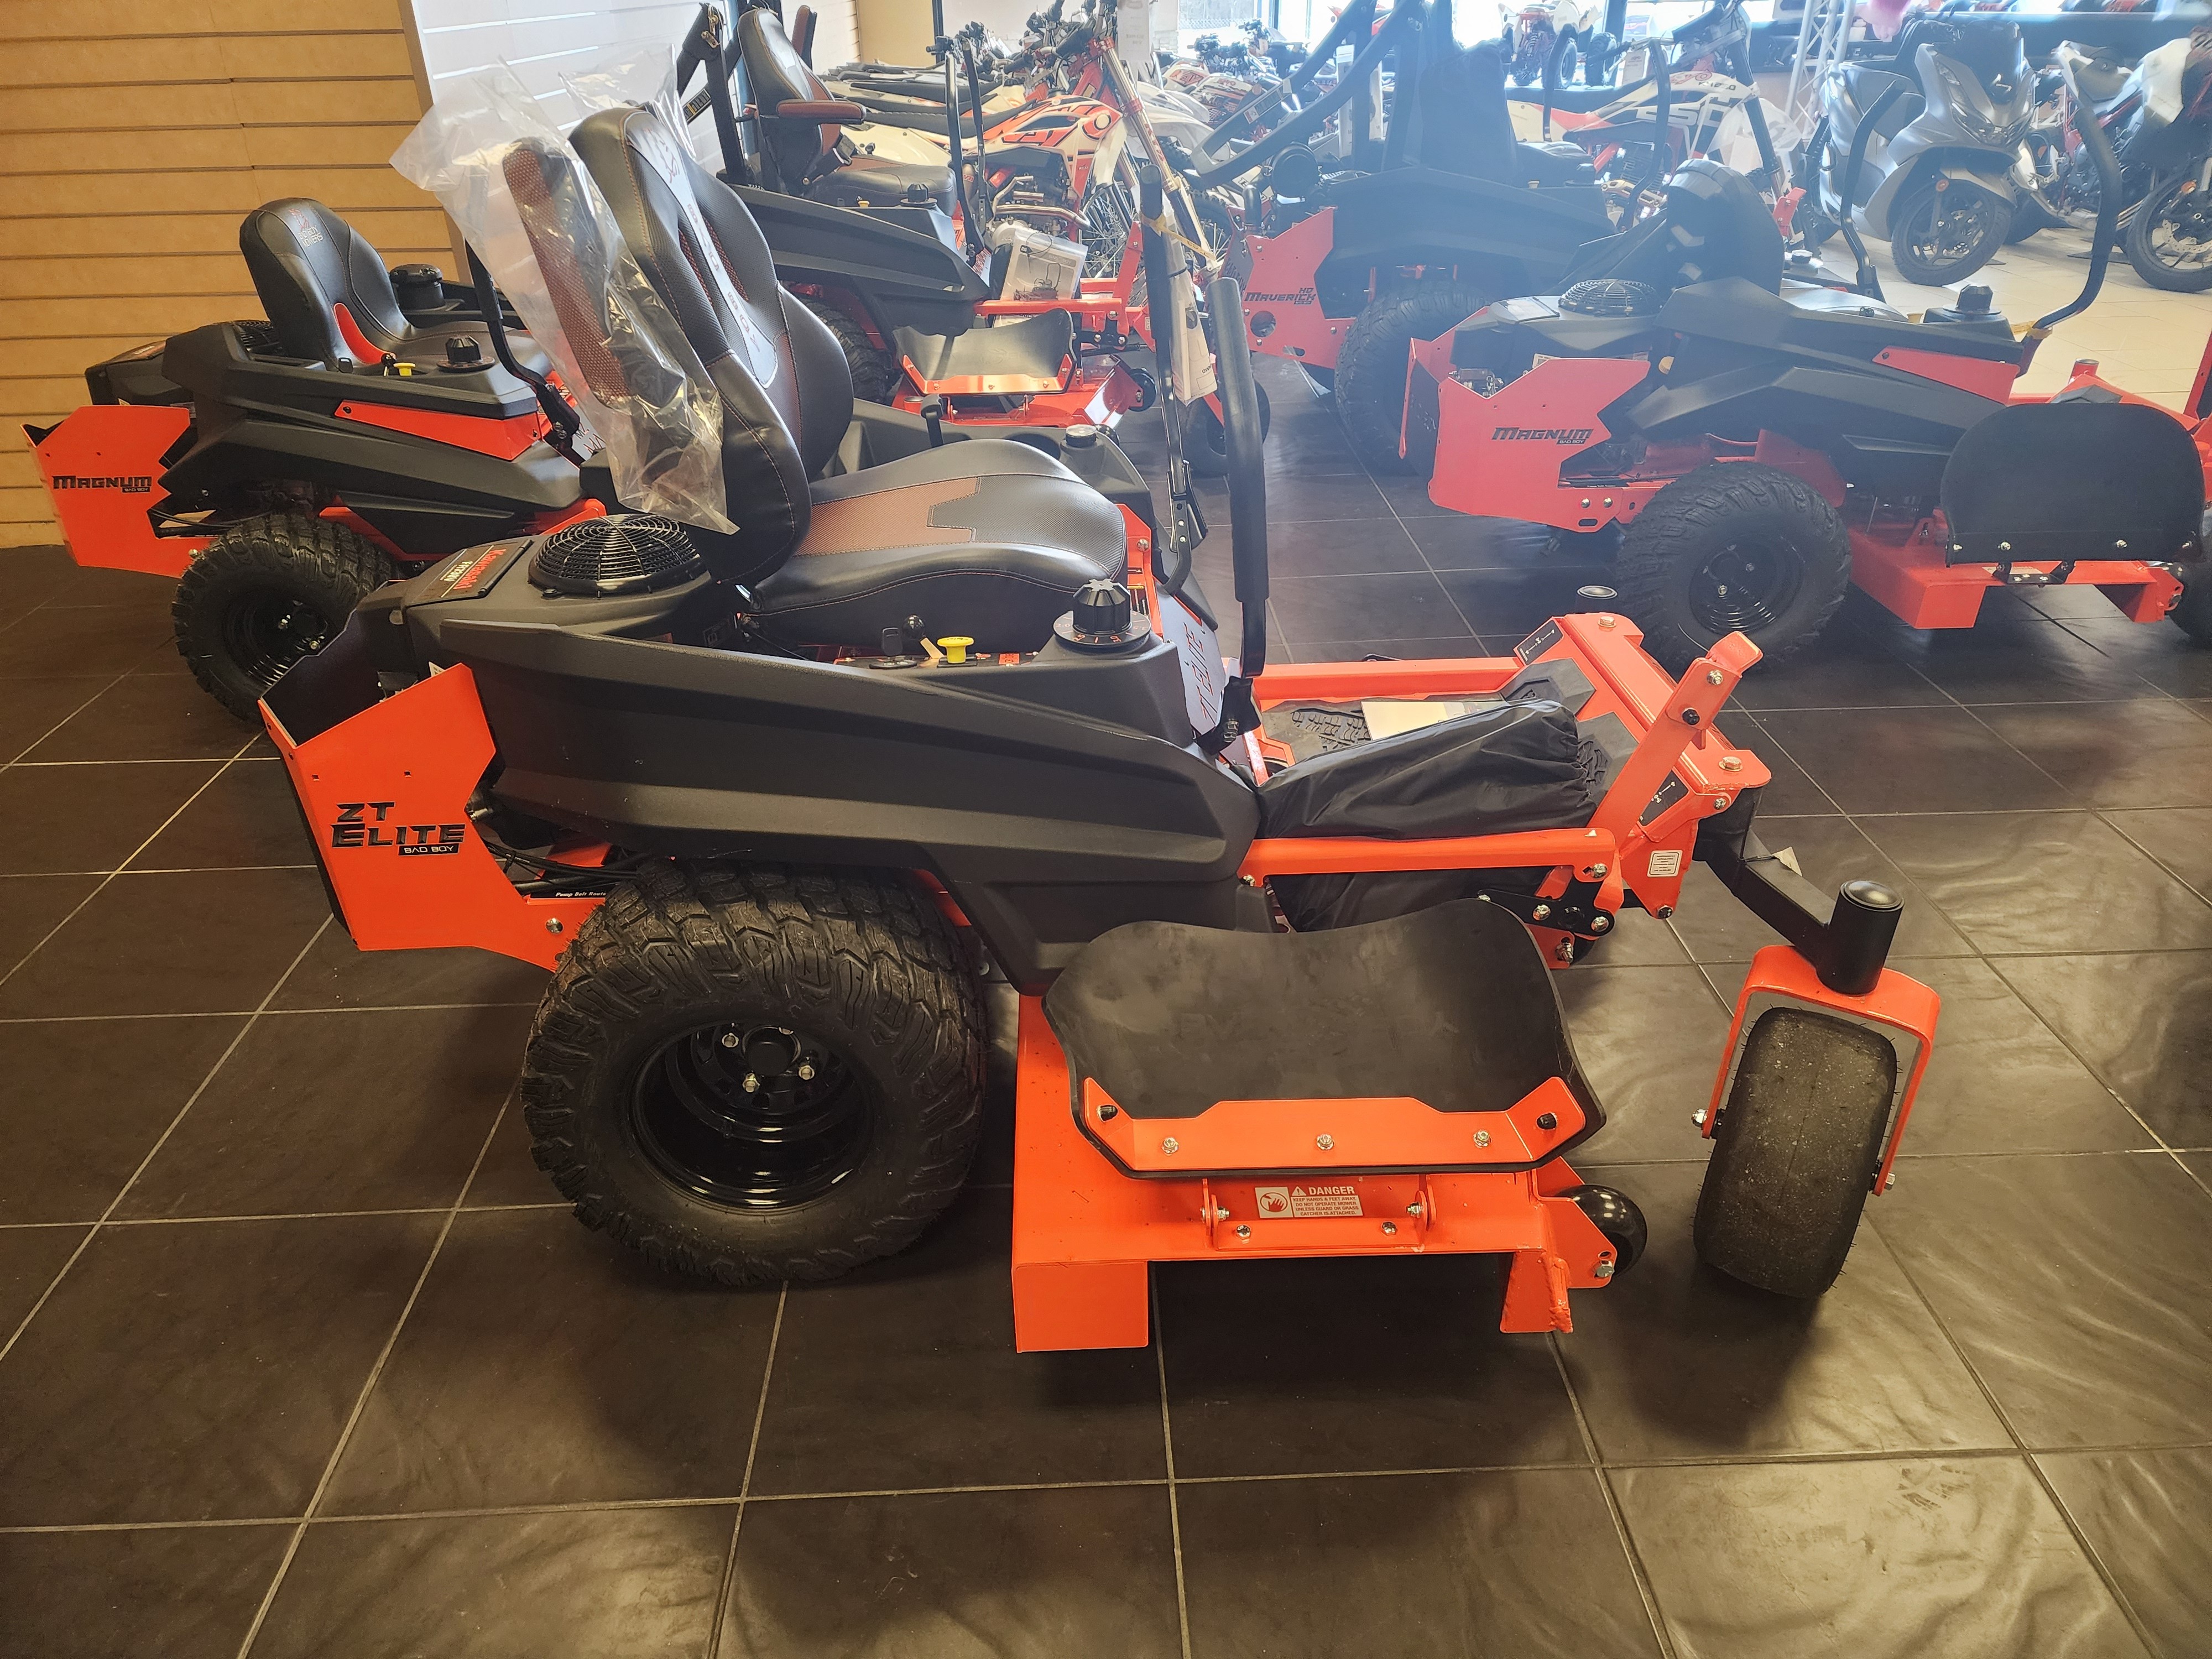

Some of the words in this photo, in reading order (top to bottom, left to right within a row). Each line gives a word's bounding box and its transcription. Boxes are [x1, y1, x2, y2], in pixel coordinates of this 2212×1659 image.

[1491, 426, 1594, 440] MAGNUM
[52, 475, 152, 489] MAGNUM
[452, 549, 507, 590] Kawasaki
[336, 801, 395, 823] ZT
[330, 823, 466, 848] ELITE
[1308, 1186, 1355, 1195] DANGER
